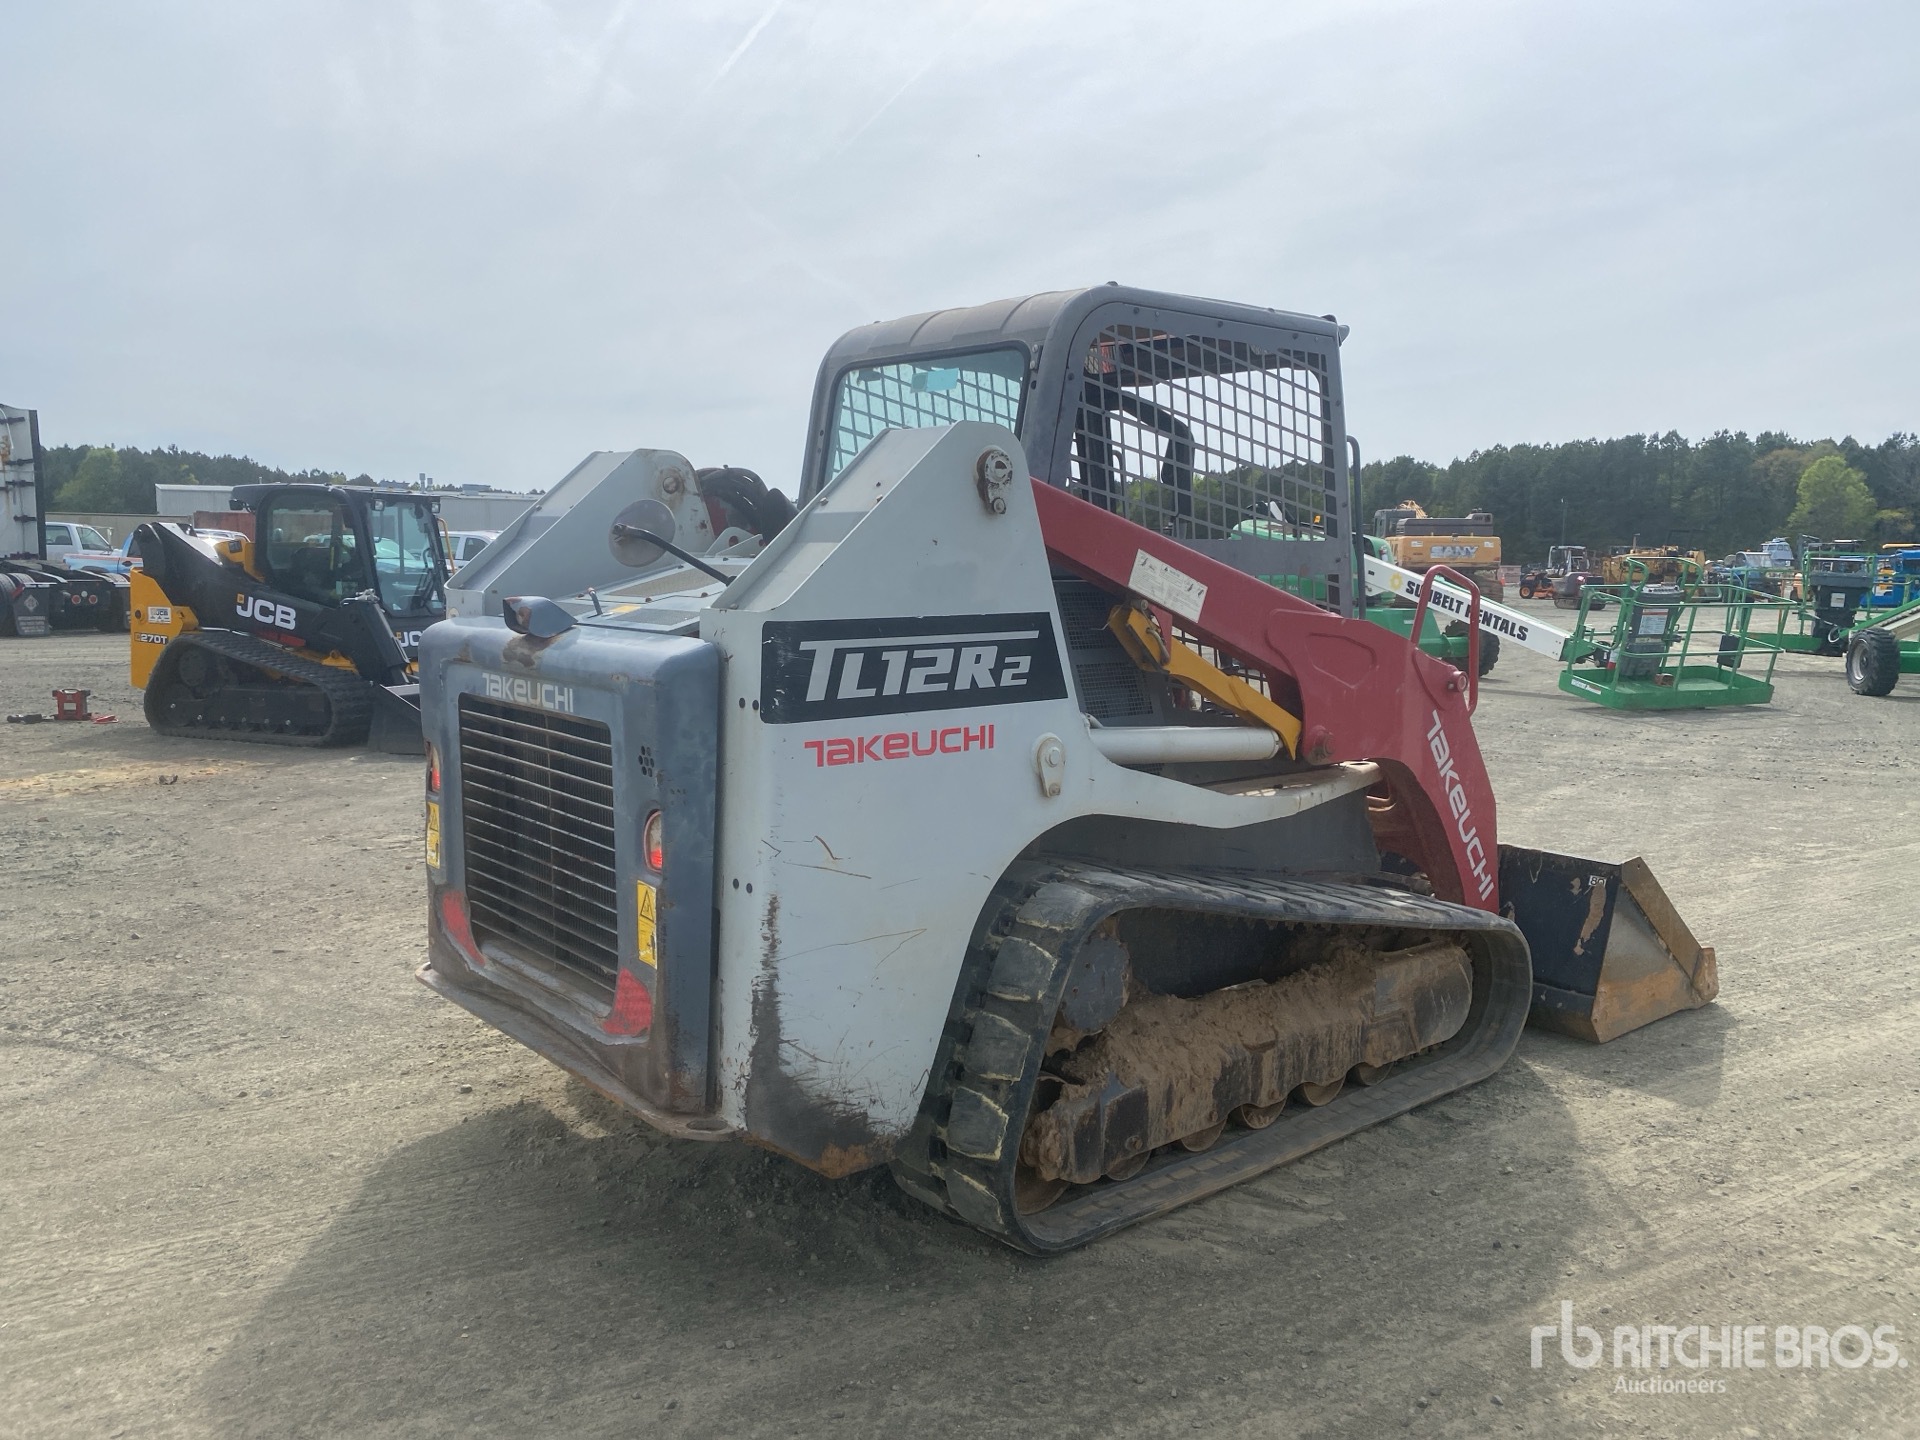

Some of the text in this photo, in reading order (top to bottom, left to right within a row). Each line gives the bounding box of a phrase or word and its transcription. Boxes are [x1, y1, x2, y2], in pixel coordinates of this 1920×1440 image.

[1430, 545, 1478, 558] SANY
[236, 596, 296, 630] JCB
[140, 633, 168, 645] 270T
[399, 631, 424, 647] JC
[482, 672, 574, 713] TAKEUCHI
[804, 724, 995, 767] TAKEUCHI
[1426, 709, 1495, 902] TAKEUCHI
